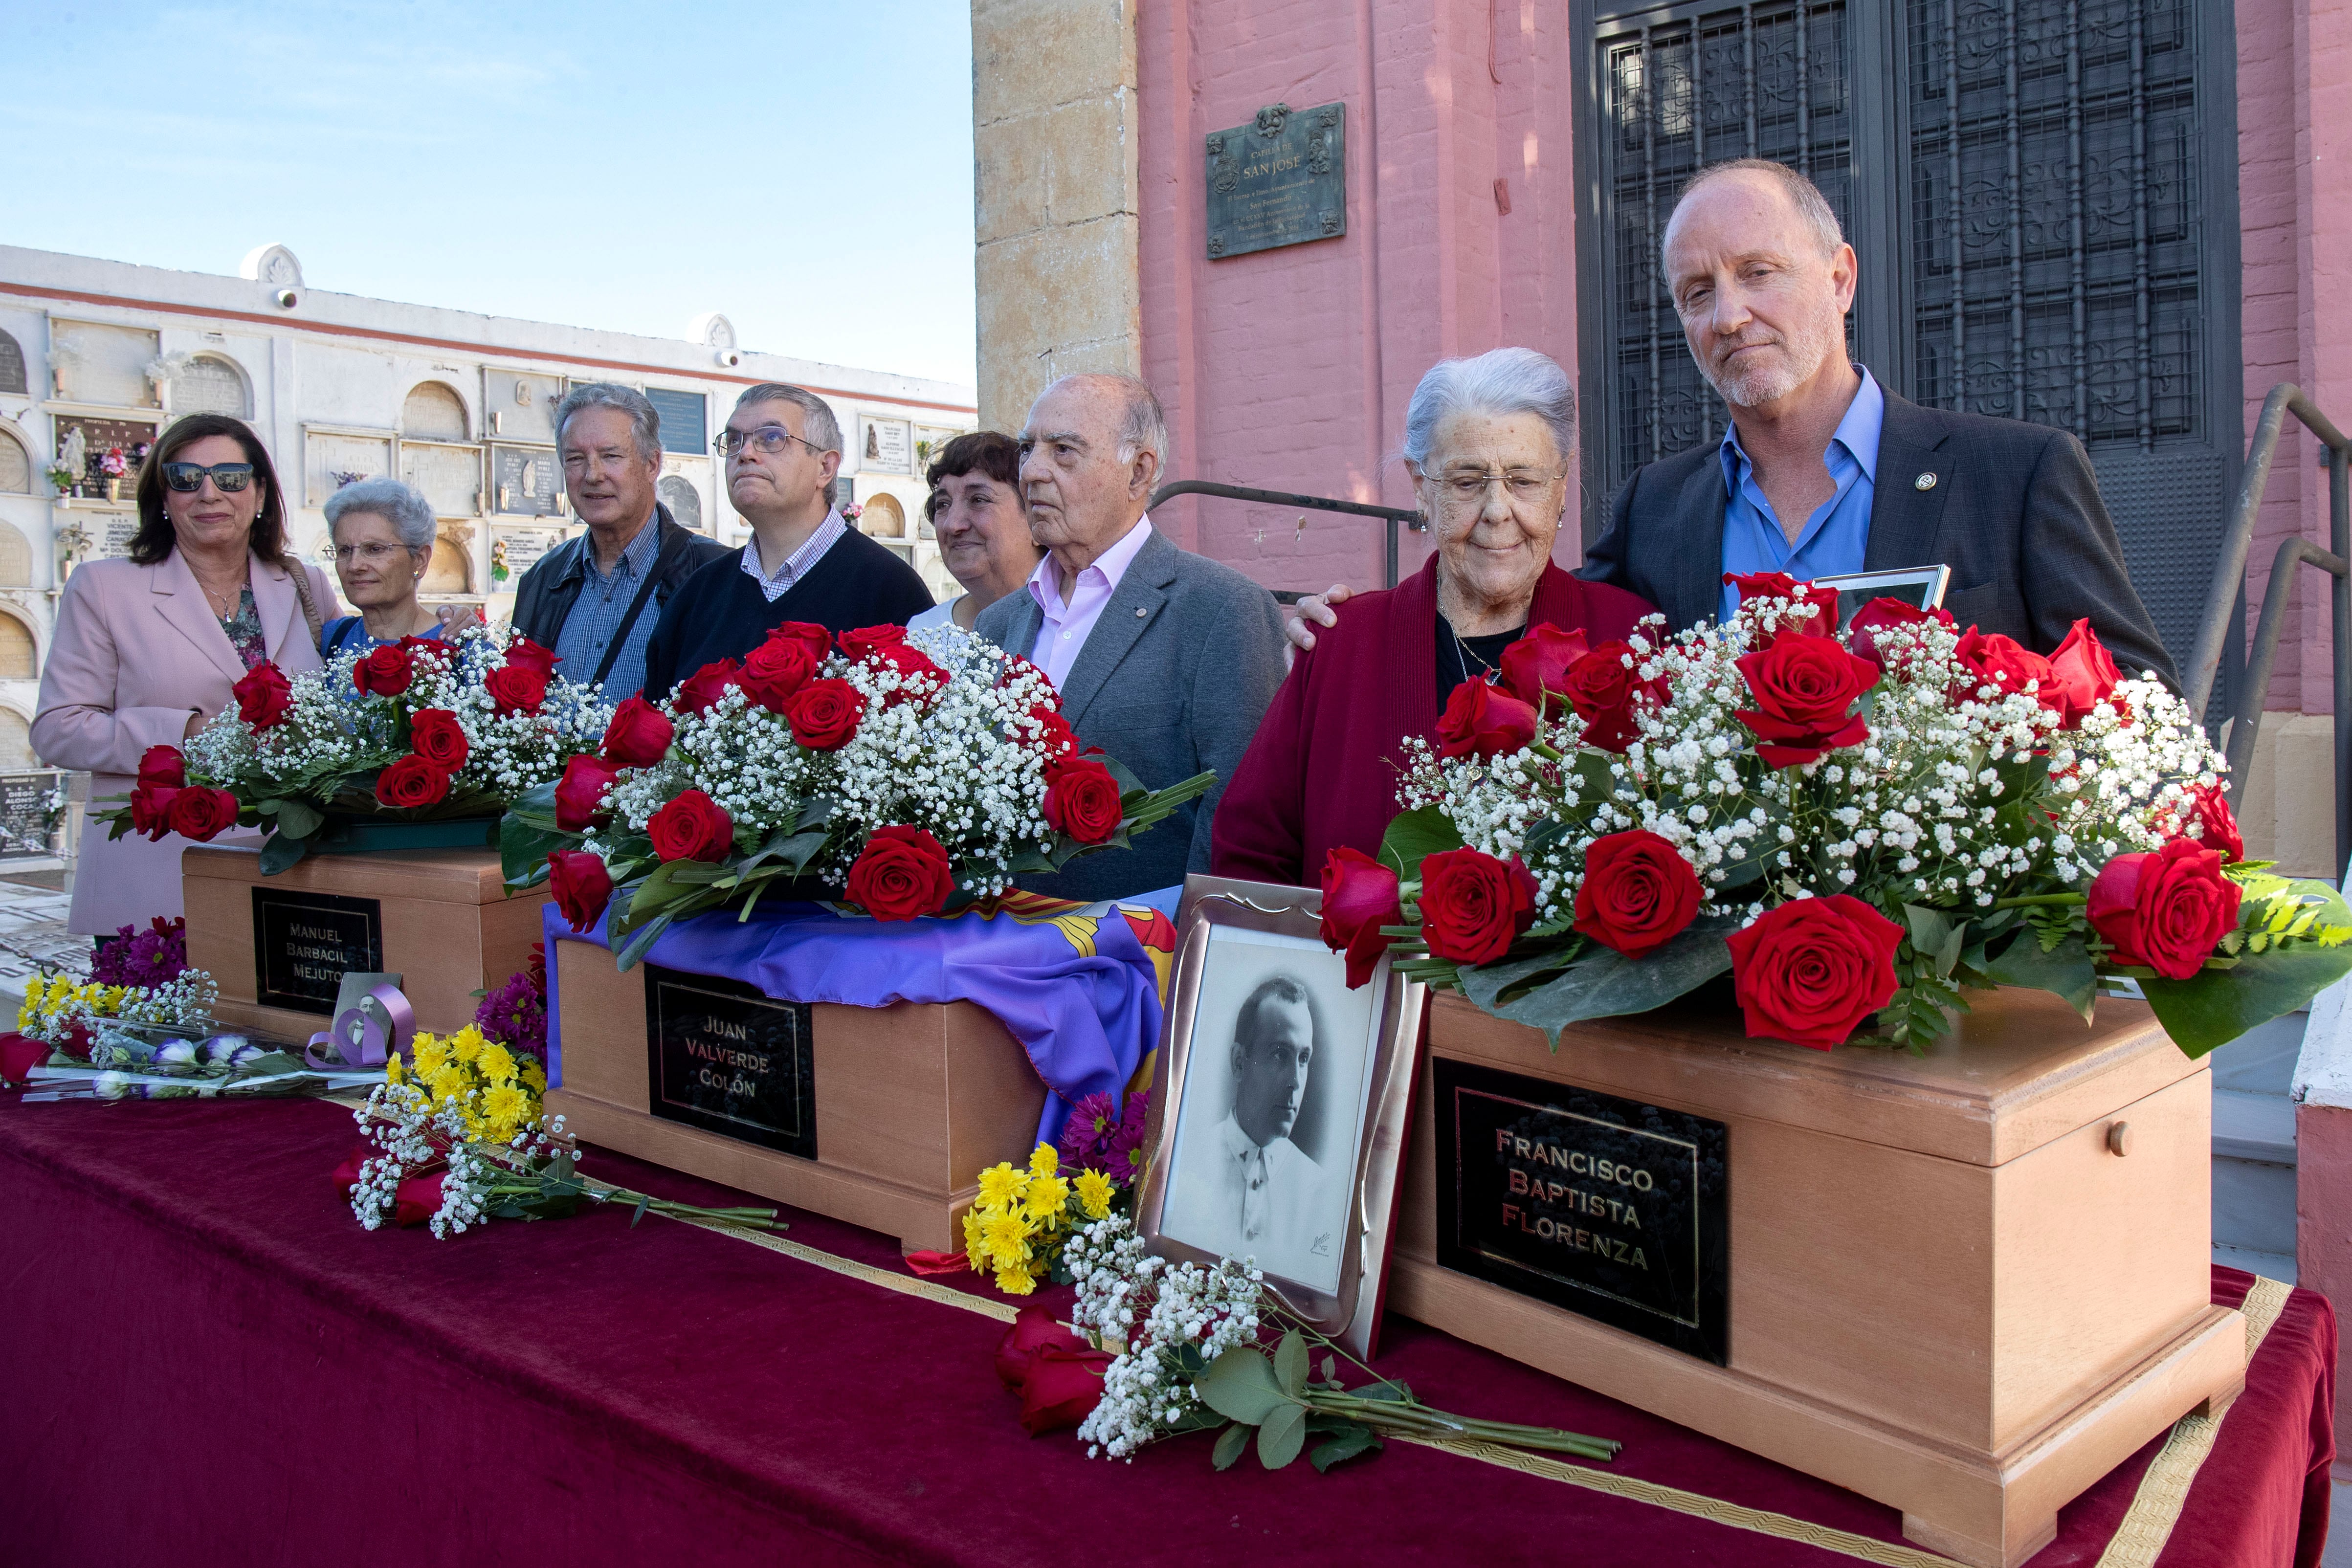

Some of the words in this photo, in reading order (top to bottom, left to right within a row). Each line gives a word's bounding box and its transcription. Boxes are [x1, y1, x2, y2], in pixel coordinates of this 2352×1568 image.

[1251, 146, 1280, 158] CAPILLA
[1282, 142, 1291, 151] DE
[1243, 163, 1268, 179] SAN
[1272, 153, 1301, 175] JOSÉ
[1271, 179, 1307, 193] Ayuntamiento
[1250, 200, 1261, 209] San
[1263, 194, 1291, 206] Fernando
[289, 923, 342, 943] MANUEL
[287, 942, 348, 963] BARBACIL
[293, 963, 342, 983] MEJUTO
[703, 1016, 747, 1041] JUAN
[686, 1038, 769, 1074] VALVERDE
[699, 1068, 756, 1098] COLÓN
[1495, 1127, 1653, 1193] FRANCISCO
[1509, 1169, 1642, 1230] BAPTISTA
[1502, 1203, 1648, 1271] FLORENZA
